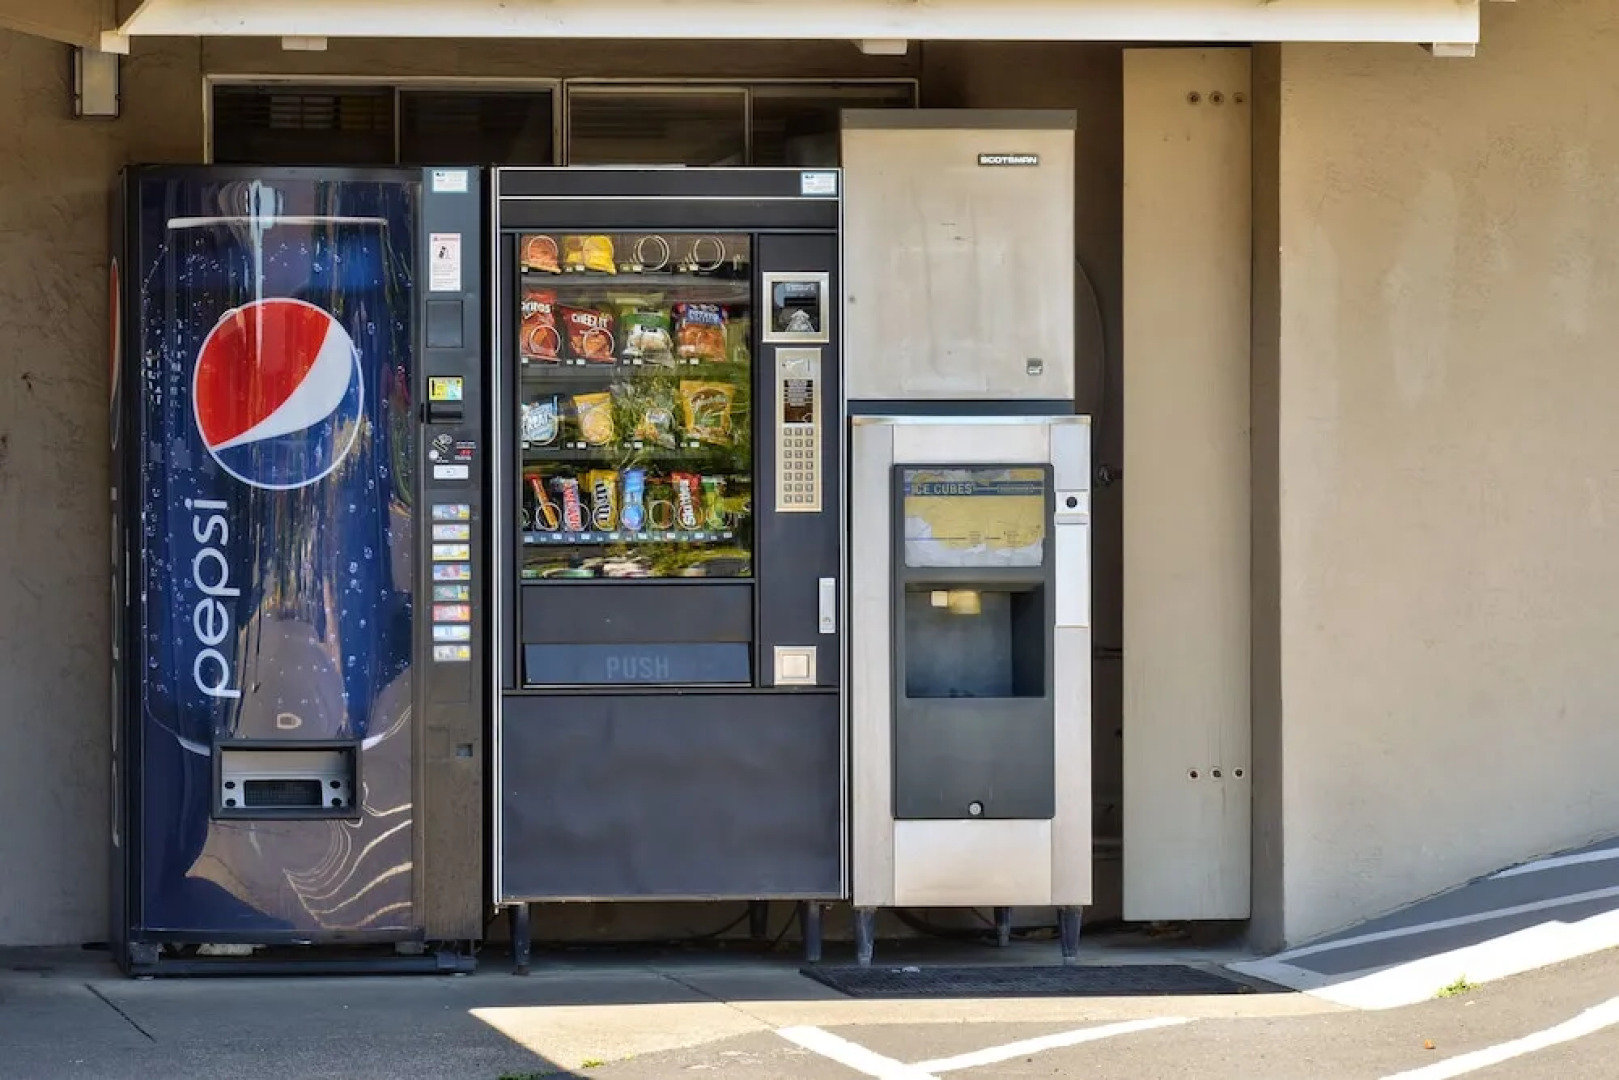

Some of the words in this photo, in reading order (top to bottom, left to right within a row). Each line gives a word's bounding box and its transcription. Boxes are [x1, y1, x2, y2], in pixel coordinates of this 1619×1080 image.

[933, 483, 972, 495] CUBES
[184, 499, 241, 698] pepsi
[606, 656, 670, 679] PUSH
